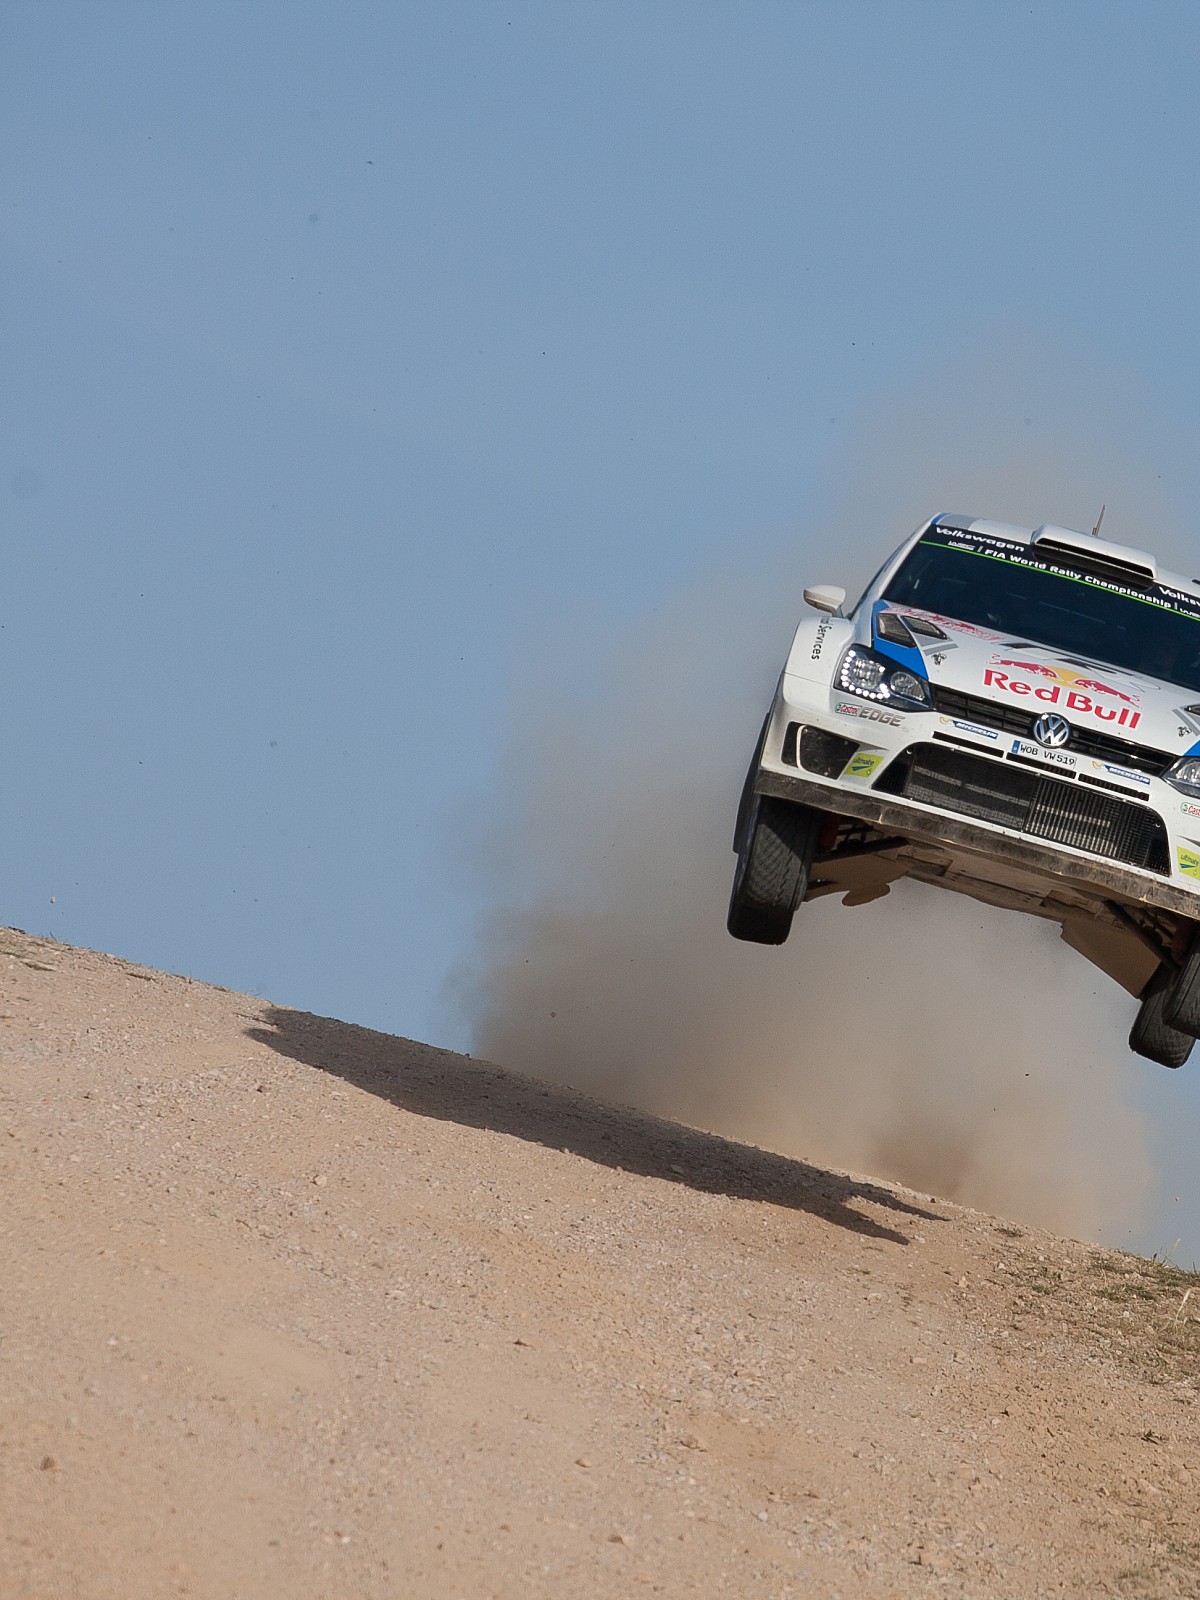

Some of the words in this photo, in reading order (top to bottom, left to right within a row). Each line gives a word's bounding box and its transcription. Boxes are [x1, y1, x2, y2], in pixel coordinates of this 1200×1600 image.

[935, 526, 1025, 553] Volkswagen
[984, 548, 1006, 560] FIA
[1010, 554, 1047, 571] World
[1049, 564, 1082, 581] Rally
[1084, 574, 1172, 609] Championship
[811, 624, 832, 660] Services
[983, 668, 1061, 704] Red
[1065, 691, 1142, 729] Bull
[859, 706, 906, 728] EDGE
[955, 720, 998, 739] MICHELIN
[1020, 743, 1039, 757] WOB
[1043, 749, 1057, 760] VW
[1056, 753, 1076, 767] 519
[1109, 766, 1150, 784] MICHELIN
